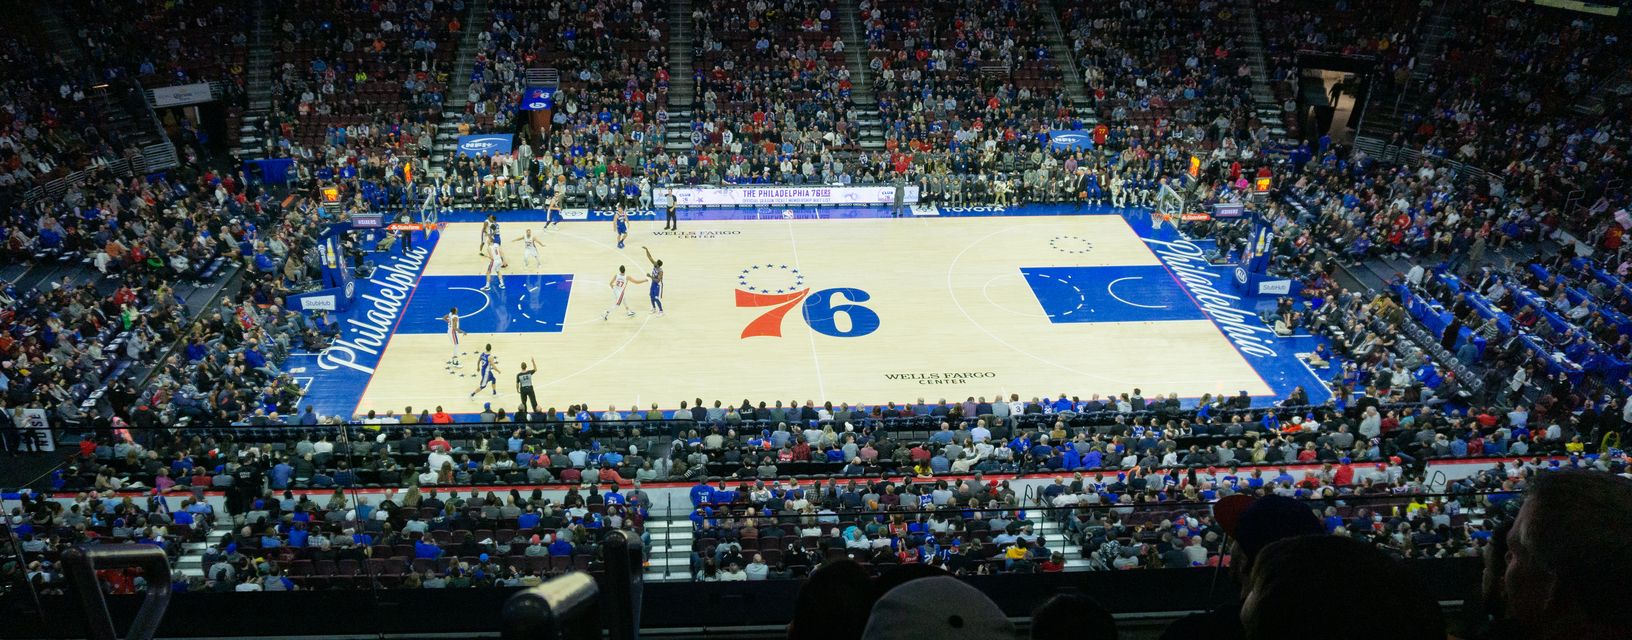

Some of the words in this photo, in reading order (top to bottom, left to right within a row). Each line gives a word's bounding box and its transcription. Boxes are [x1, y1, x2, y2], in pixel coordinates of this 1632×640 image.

[317, 246, 429, 375] Philadelphia
[734, 287, 880, 340] 76
[1139, 237, 1278, 358] Philadelphia
[884, 372, 940, 380] WELLS
[944, 371, 996, 379] FARGO
